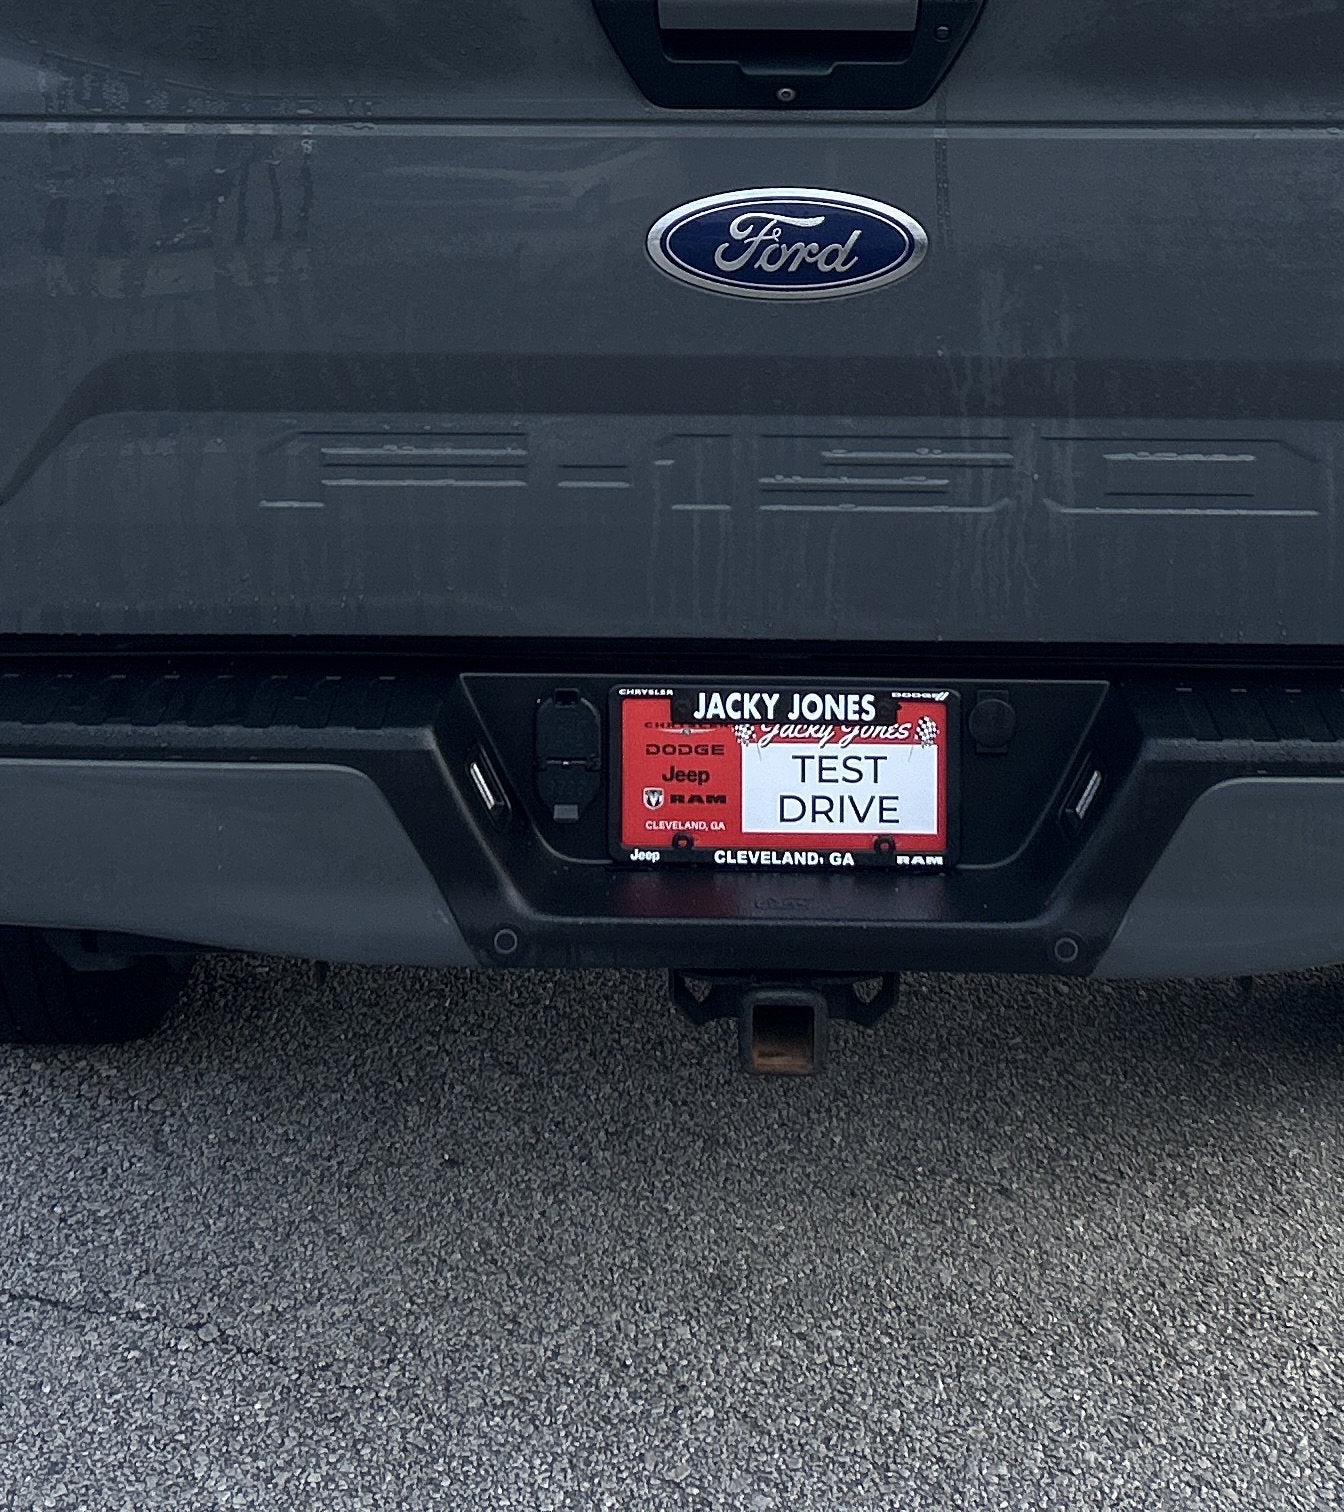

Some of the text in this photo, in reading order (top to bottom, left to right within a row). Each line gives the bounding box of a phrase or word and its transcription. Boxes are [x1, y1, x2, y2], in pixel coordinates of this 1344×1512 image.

[714, 212, 862, 272] Ford
[693, 692, 876, 721] JACKY JONES
[645, 743, 725, 756] DODGE
[662, 765, 710, 786] Jeep
[791, 754, 888, 784] TEST
[669, 794, 727, 804] RAM
[779, 794, 900, 824] DRIVE
[645, 820, 726, 831] CLEVELAND, GA
[629, 848, 661, 863] Jeep
[829, 852, 854, 866] GA
[896, 855, 944, 865] RAM
